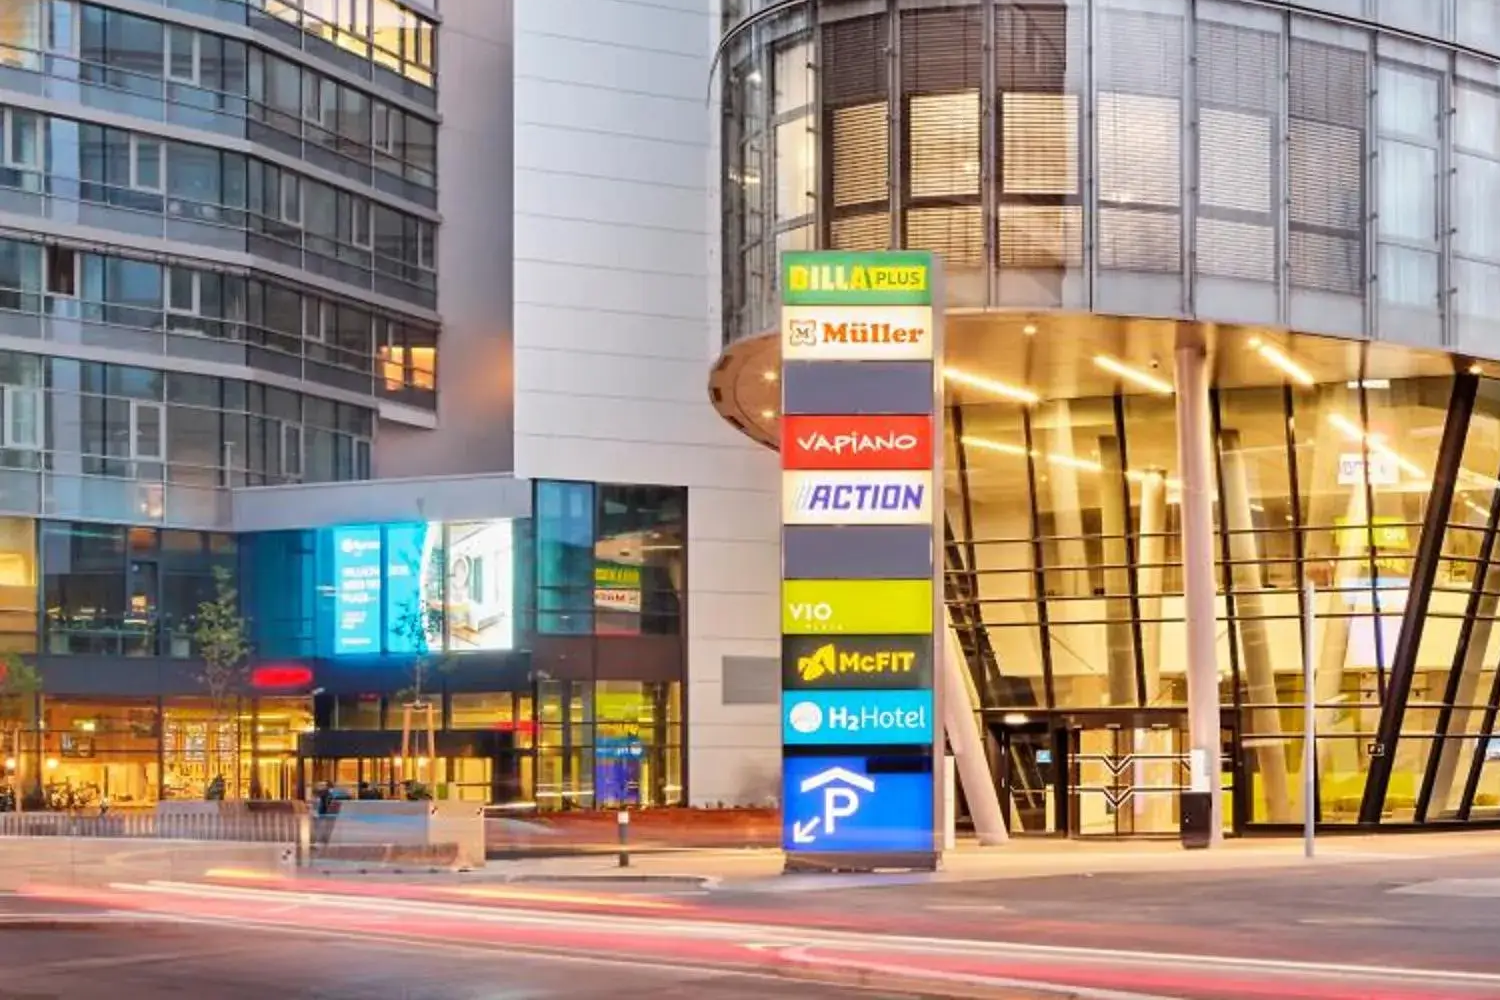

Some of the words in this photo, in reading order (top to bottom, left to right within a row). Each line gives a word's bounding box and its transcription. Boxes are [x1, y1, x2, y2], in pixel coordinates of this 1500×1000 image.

[875, 271, 921, 286] PLUS
[822, 321, 925, 343] Müller
[808, 484, 924, 510] ACTION
[824, 787, 859, 834] P
